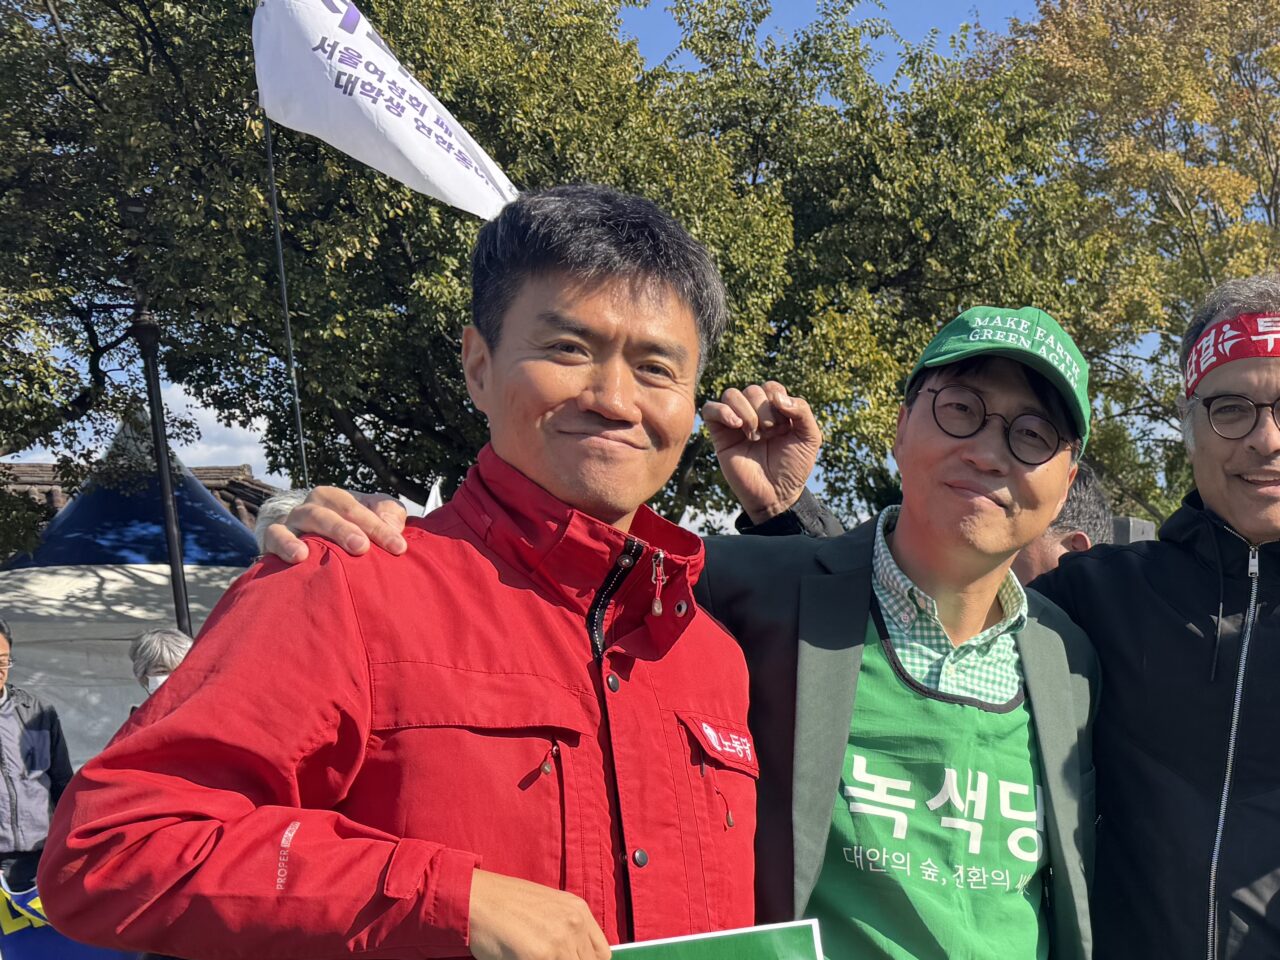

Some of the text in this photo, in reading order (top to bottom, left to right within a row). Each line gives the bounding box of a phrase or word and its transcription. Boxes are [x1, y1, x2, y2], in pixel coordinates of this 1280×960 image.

[312, 36, 429, 117] 서울여성회
[334, 70, 407, 118] 대학생
[968, 328, 1078, 390] GREEN AGAIN
[972, 316, 1081, 380] MAKE EARTH
[1185, 329, 1217, 389] 단결
[718, 732, 752, 761] 노동당
[844, 754, 1045, 862] 녹색당
[275, 849, 289, 890] PROPER
[842, 845, 911, 876] 대안의
